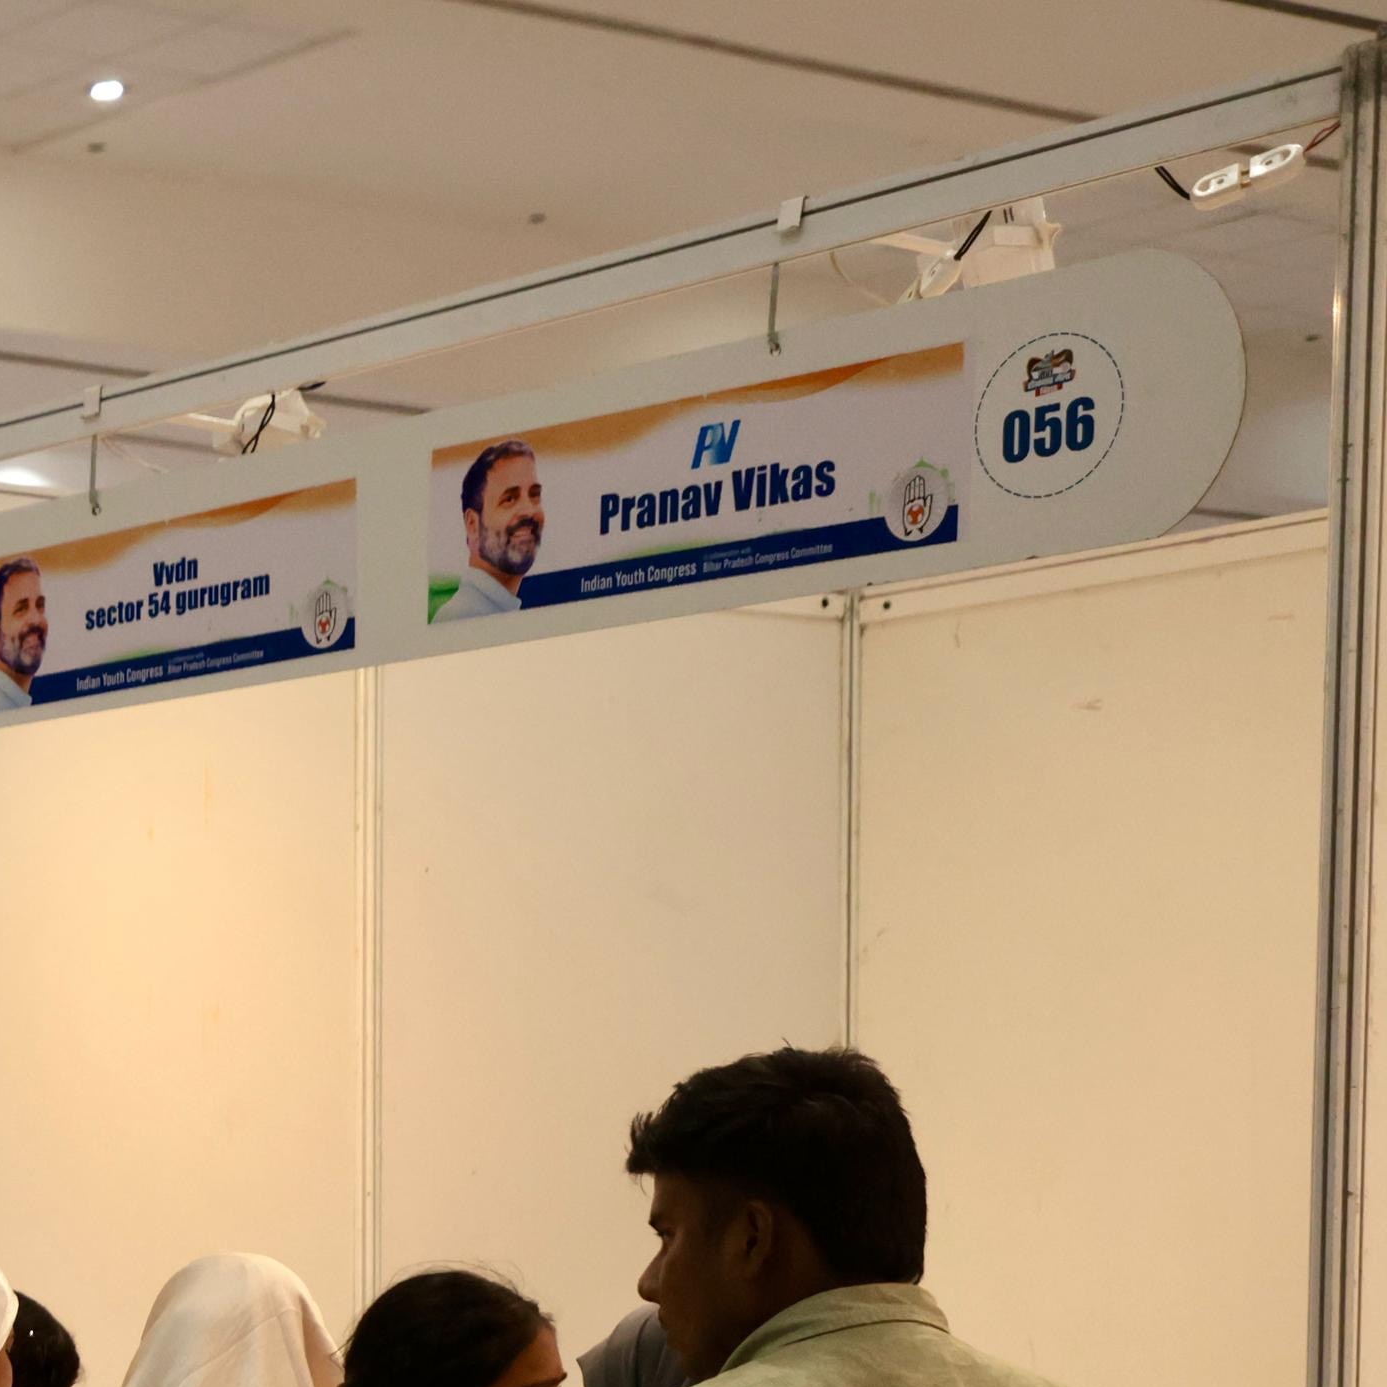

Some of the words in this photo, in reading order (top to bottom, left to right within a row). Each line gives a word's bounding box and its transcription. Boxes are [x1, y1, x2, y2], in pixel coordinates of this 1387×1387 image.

[1002, 396, 1095, 464] 056
[599, 480, 723, 535] Pranav
[732, 460, 836, 512] Vikas
[153, 556, 198, 587] Vvdn
[754, 551, 790, 568] Congress
[580, 575, 613, 593] Indian
[615, 570, 645, 588] Youth
[647, 561, 697, 583] Congress
[85, 599, 144, 630] sector
[148, 590, 171, 618] 54
[176, 574, 270, 615] gurugram
[76, 676, 101, 691] Indian
[102, 670, 125, 686] Youth
[126, 664, 164, 683] Congress
